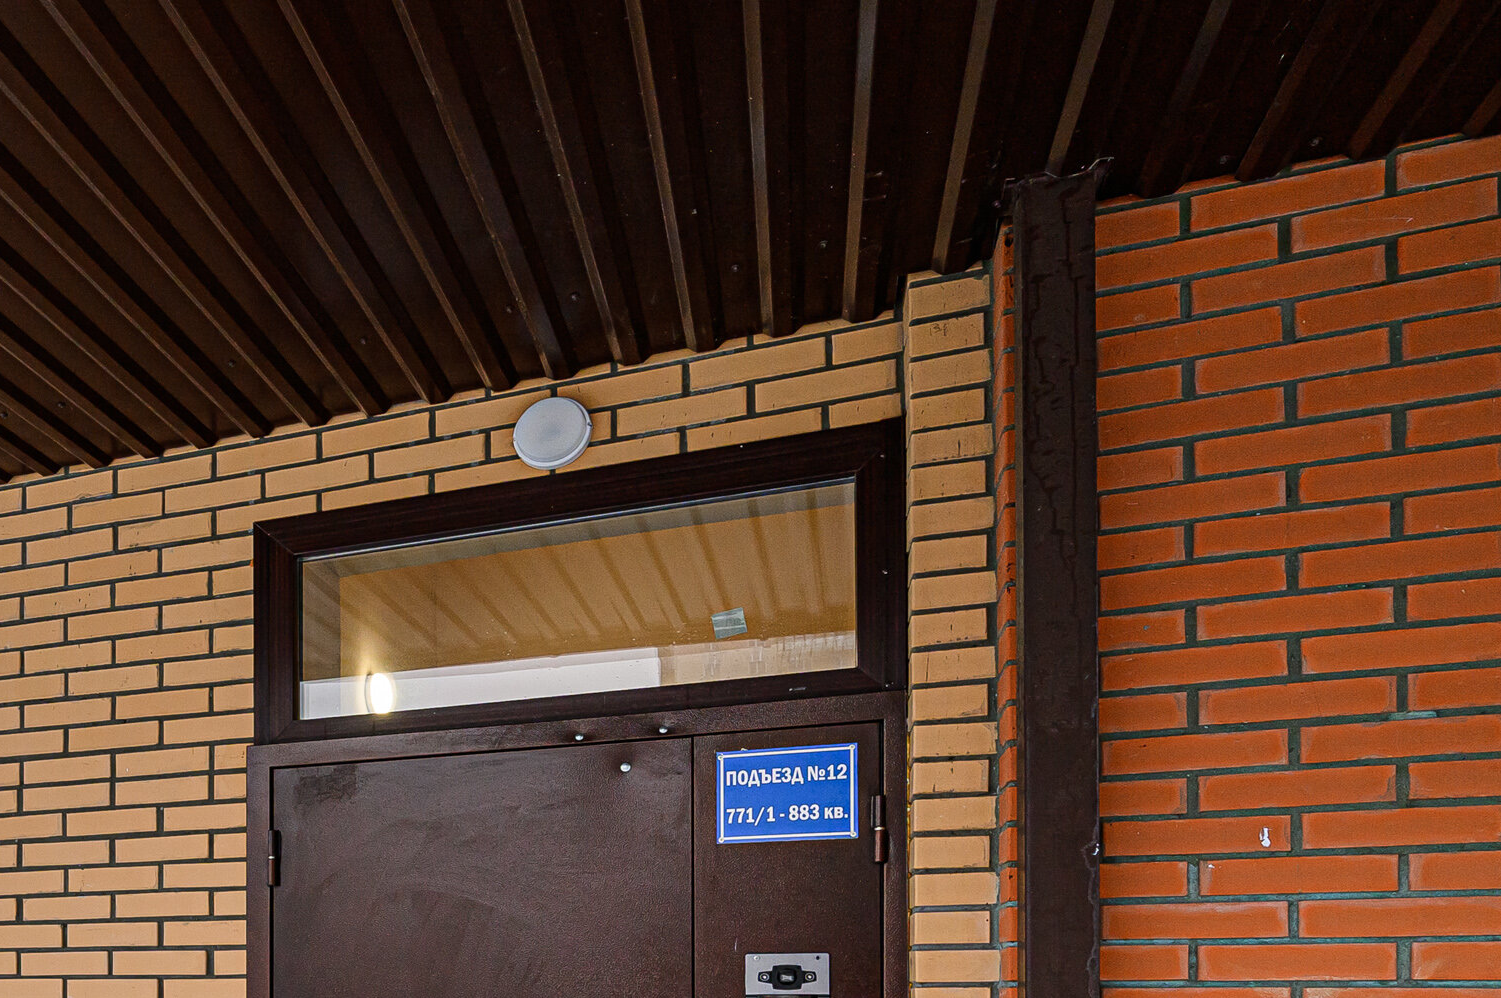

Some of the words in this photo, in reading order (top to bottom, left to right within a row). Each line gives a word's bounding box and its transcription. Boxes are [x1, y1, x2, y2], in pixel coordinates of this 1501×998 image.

[726, 766, 804, 787] ПОДЪЕЗД
[807, 763, 847, 781] №12
[726, 806, 776, 826] 771/1
[788, 803, 820, 821] 883
[824, 807, 849, 820] кв.
